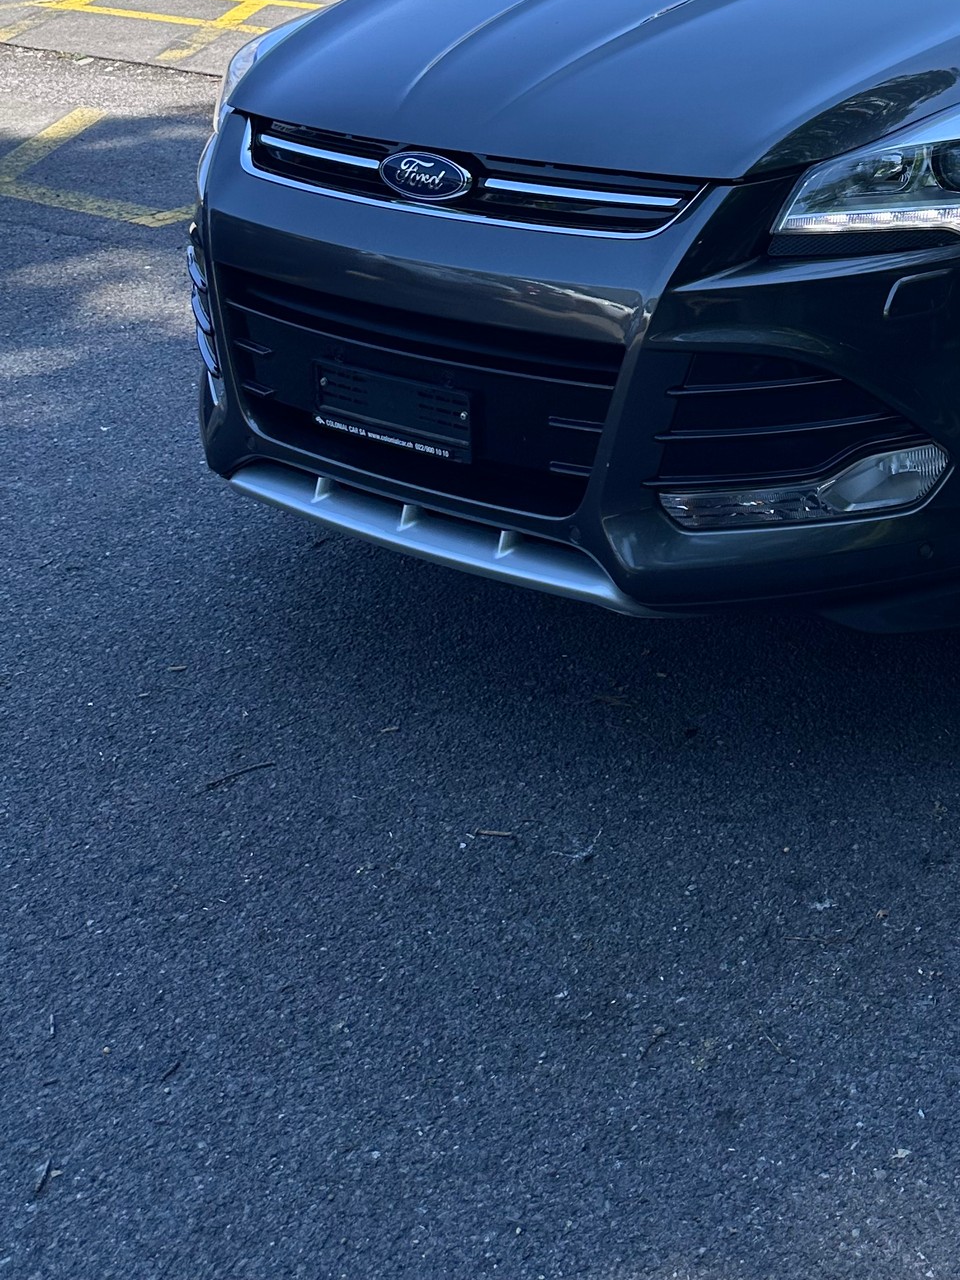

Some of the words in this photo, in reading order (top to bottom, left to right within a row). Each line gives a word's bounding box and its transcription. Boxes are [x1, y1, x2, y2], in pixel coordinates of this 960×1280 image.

[395, 158, 446, 190] Ford
[325, 419, 348, 431] COLONIAL
[348, 425, 359, 434] CAR
[359, 428, 366, 436] SA
[367, 431, 414, 448] www.colonialcar.ch
